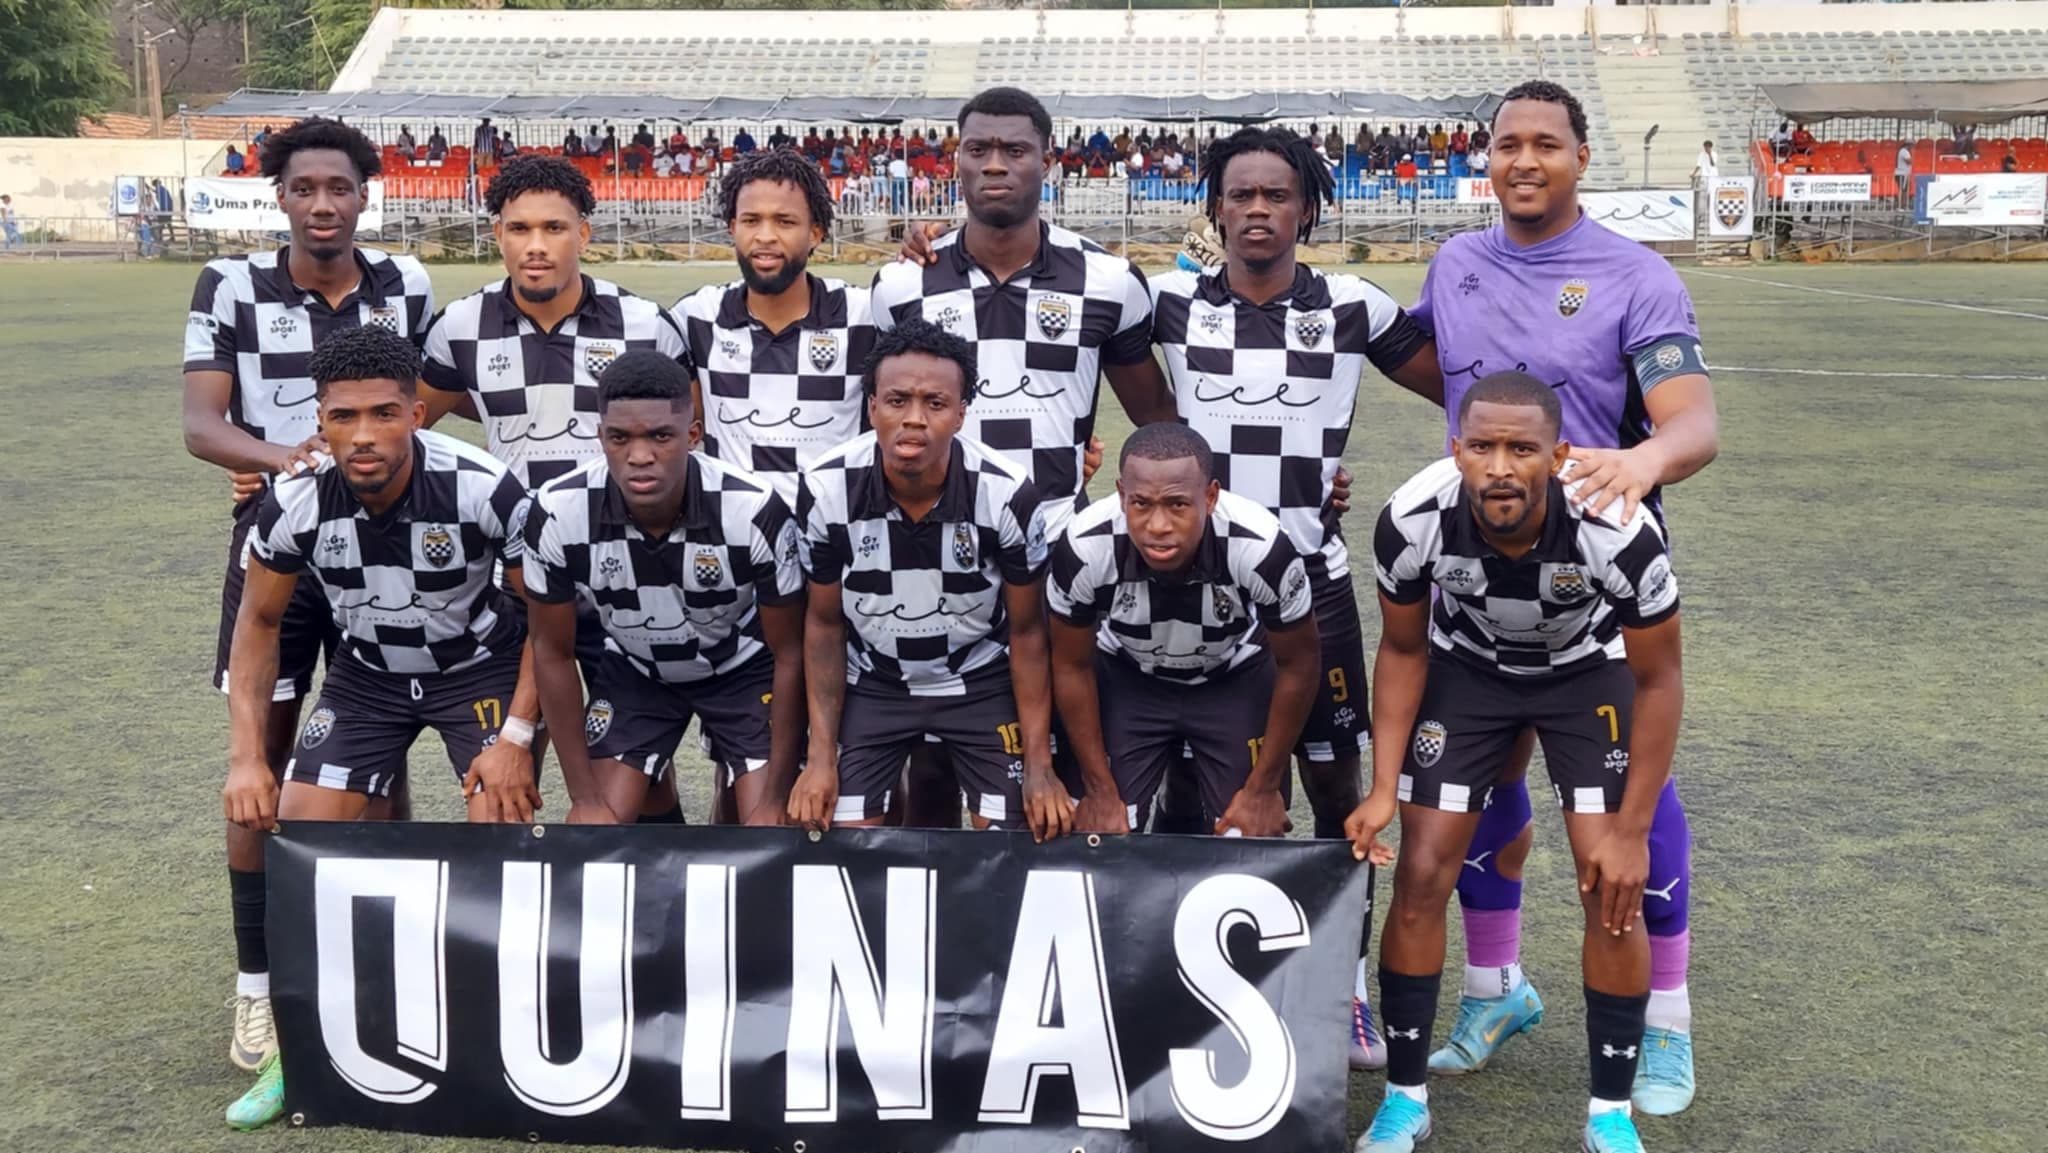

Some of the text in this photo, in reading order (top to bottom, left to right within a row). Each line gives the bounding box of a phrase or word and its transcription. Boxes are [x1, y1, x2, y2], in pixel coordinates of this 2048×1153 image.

[214, 198, 280, 210] Uma Pra
[1587, 204, 1676, 221] ce
[270, 326, 297, 334] SPORT
[975, 375, 1066, 399] ce
[1194, 378, 1321, 407] ice
[718, 402, 835, 429] ice
[858, 543, 880, 552] PORT
[1328, 667, 1348, 702] 9
[473, 698, 501, 730] 17
[1596, 705, 1619, 742] 7
[1604, 759, 1630, 769] SPOR
[314, 856, 1312, 1142] QUINAS
